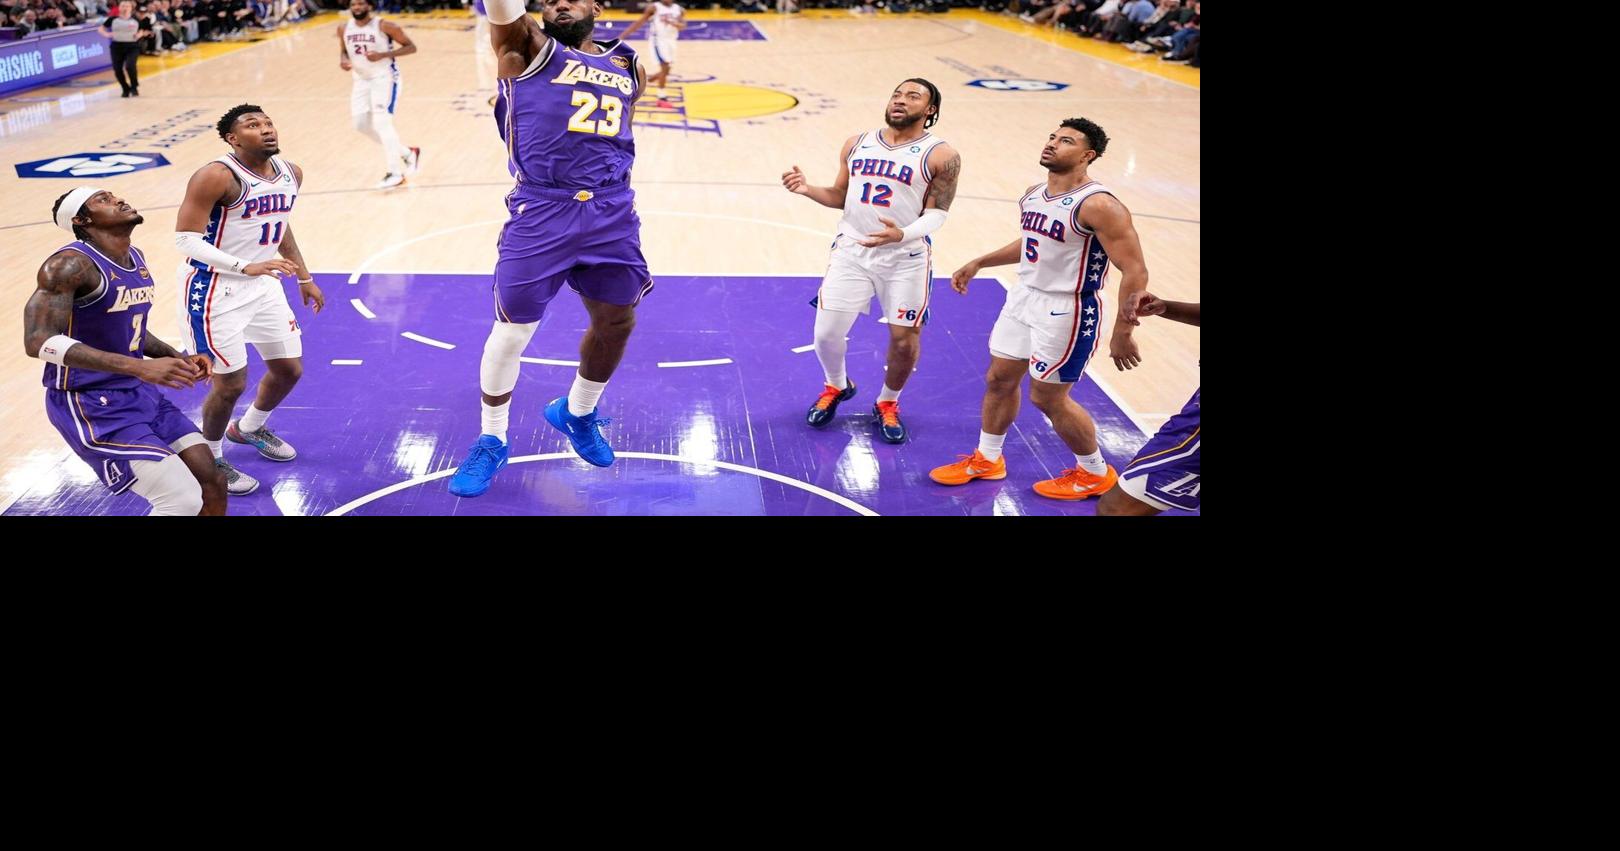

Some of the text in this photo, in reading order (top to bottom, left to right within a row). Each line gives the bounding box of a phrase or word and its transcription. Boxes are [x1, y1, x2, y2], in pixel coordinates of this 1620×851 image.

[347, 33, 375, 44] PHILA
[354, 44, 368, 55] 21
[0, 50, 44, 83] RISING
[550, 59, 633, 95] LAKERS
[567, 90, 623, 137] 23
[851, 158, 913, 186] PHILA
[860, 182, 893, 208] 12
[259, 221, 282, 245] 11
[1025, 237, 1039, 263] 5
[897, 308, 917, 321] 76
[128, 313, 144, 352] 2
[1031, 354, 1048, 372] 76
